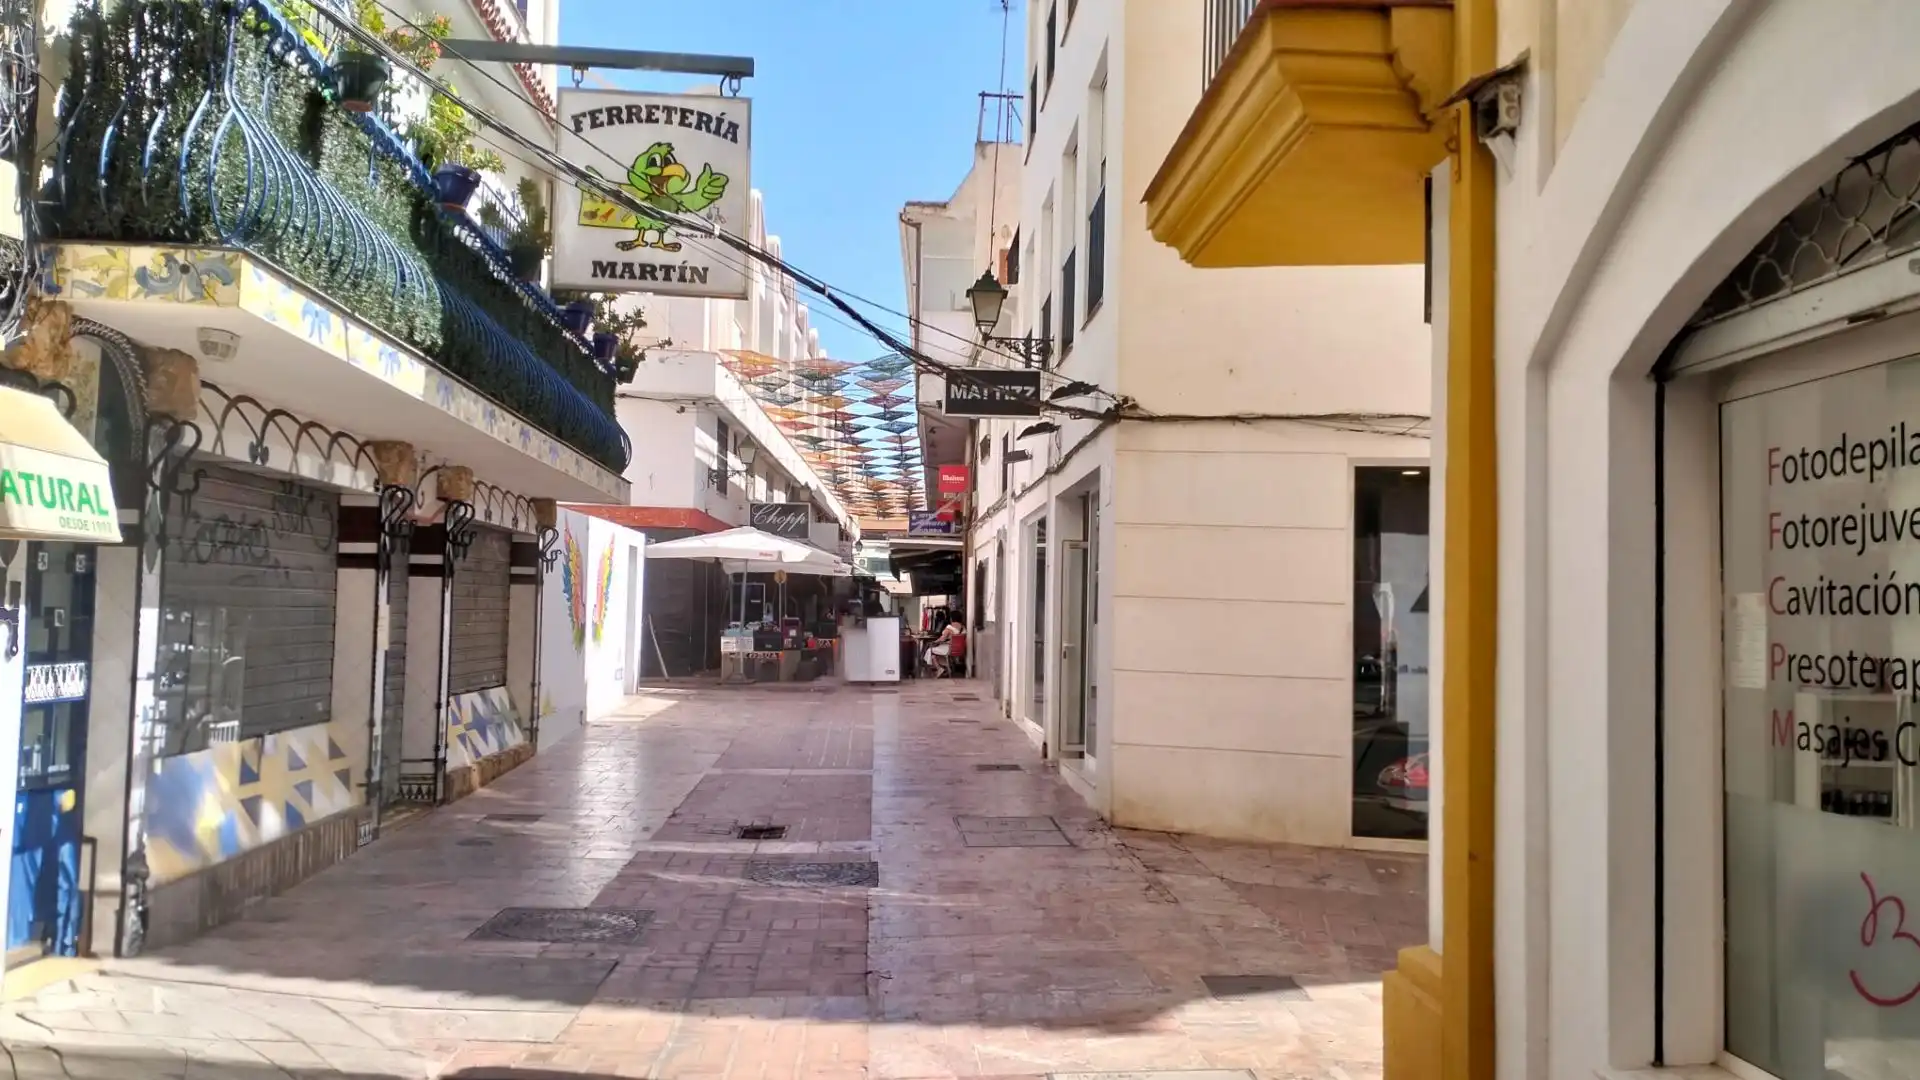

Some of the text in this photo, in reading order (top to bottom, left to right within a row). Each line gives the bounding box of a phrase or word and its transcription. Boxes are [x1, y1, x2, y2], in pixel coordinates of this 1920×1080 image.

[571, 104, 740, 144] FERRETERÍA
[592, 261, 708, 284] MARTÍN
[1768, 421, 1920, 486] Fotodepila
[0, 469, 109, 516] ATURAL
[59, 516, 90, 532] DESDE
[752, 504, 805, 531] Chopp
[1769, 571, 1920, 616] Cavitación
[1772, 709, 1920, 768] Masajes C
